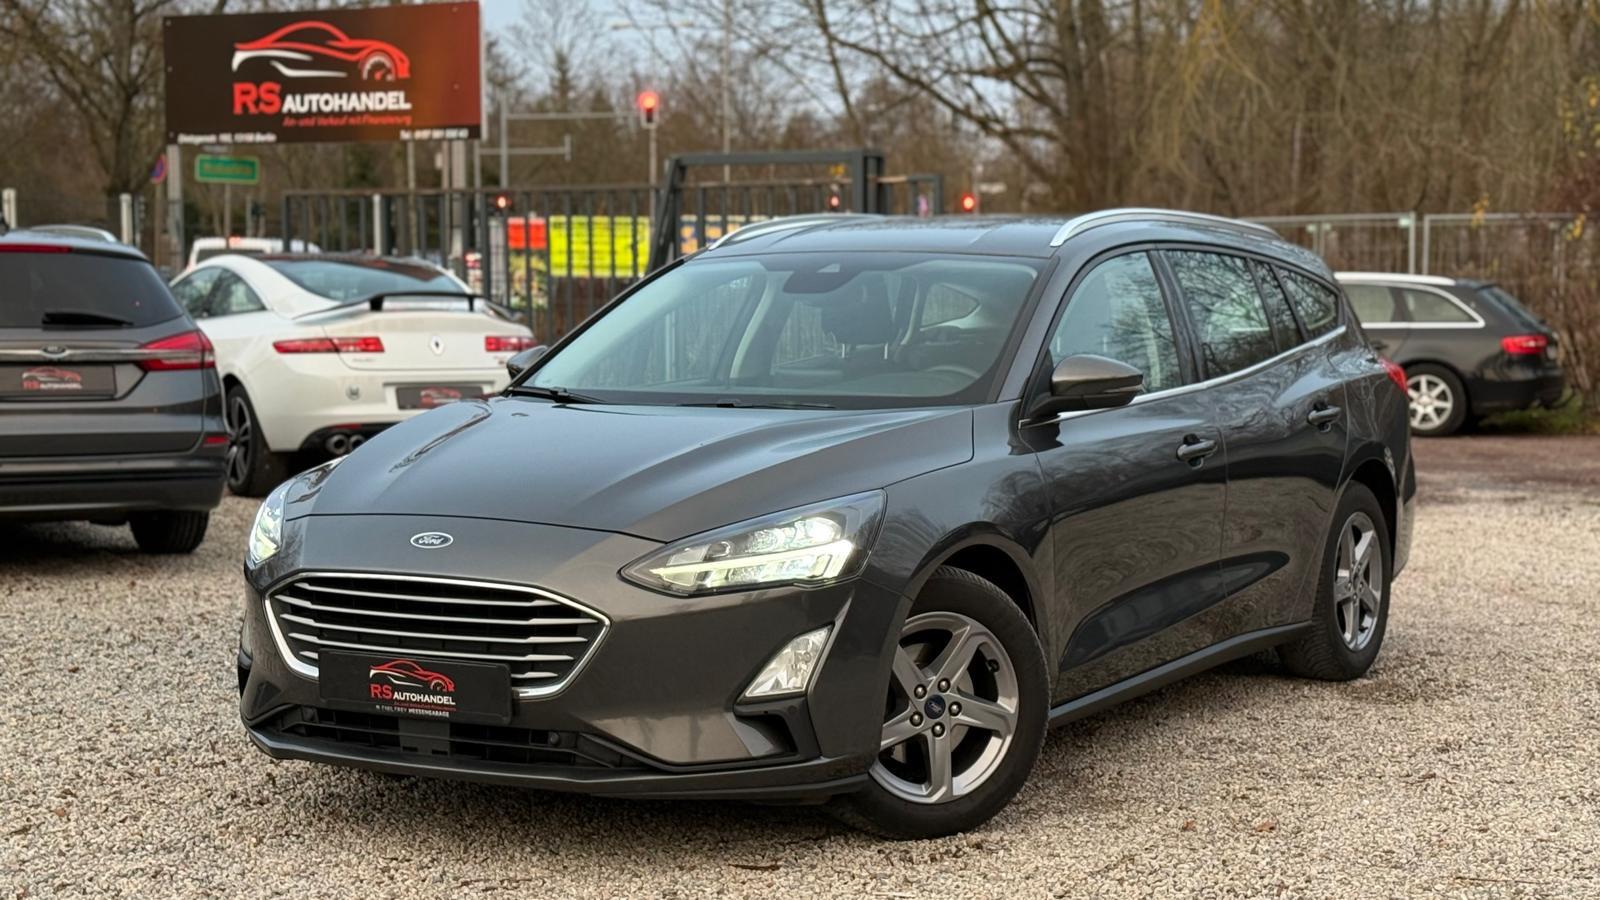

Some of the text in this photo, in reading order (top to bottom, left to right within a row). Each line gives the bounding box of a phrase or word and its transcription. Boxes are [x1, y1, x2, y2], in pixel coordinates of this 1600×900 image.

[233, 82, 412, 115] RS AUTOHANDEL
[370, 684, 457, 705] RS AUTOHANDEL
